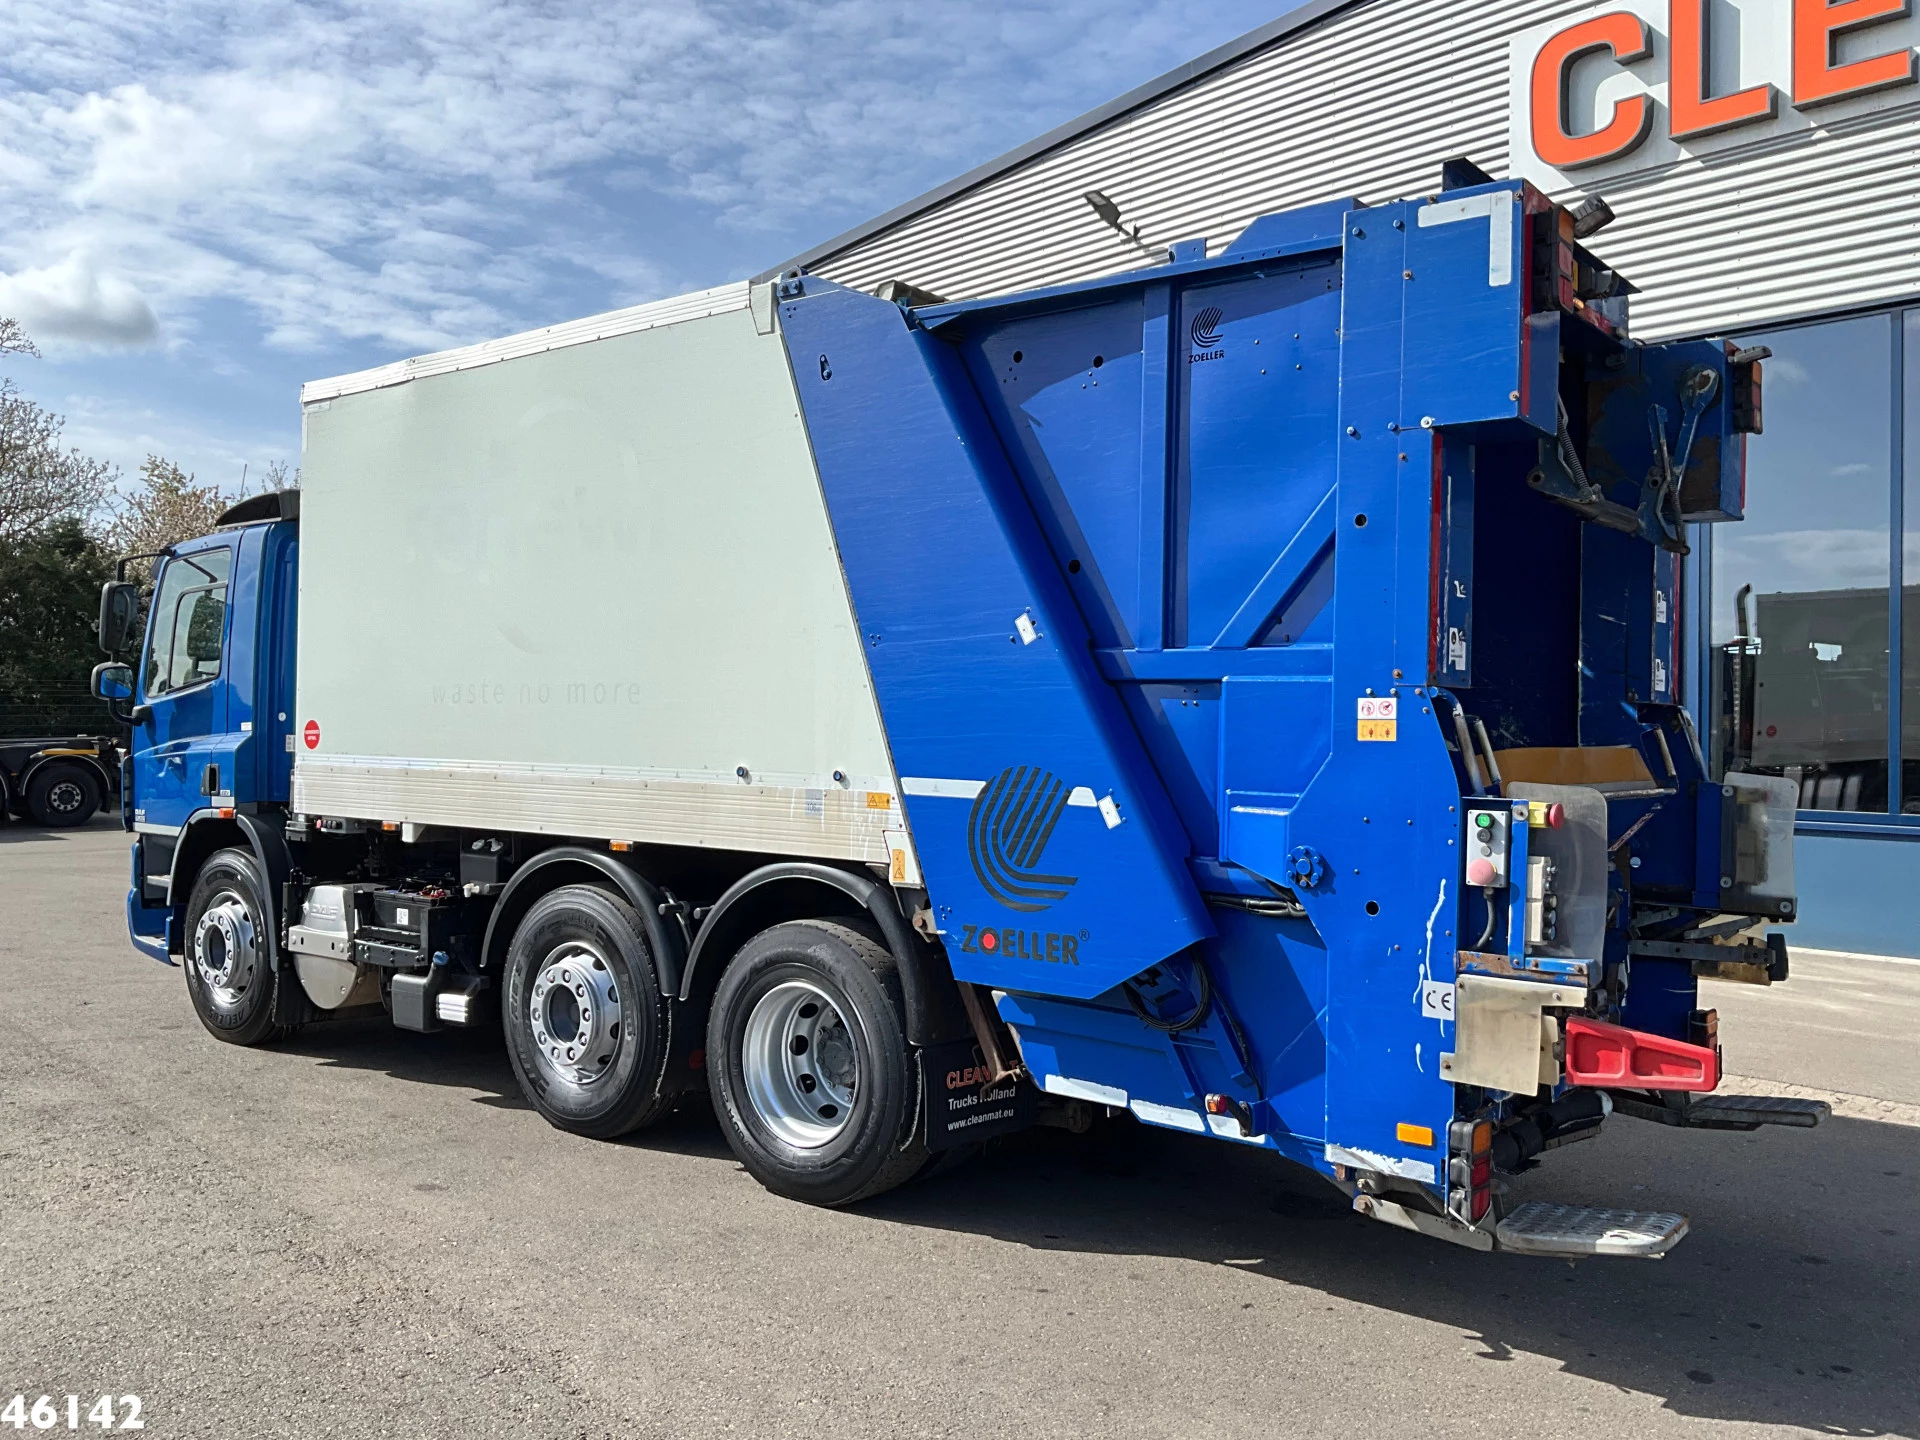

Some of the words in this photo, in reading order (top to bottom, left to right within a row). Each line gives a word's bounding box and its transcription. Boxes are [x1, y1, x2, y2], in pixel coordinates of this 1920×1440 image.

[1531, 0, 1918, 171] CLE
[1188, 350, 1225, 364] ZOELLER
[432, 678, 504, 705] waste
[519, 682, 551, 705] no
[567, 681, 641, 705] more
[948, 1094, 978, 1111] Trucks
[947, 1108, 1014, 1131] www.cleanmat.eu
